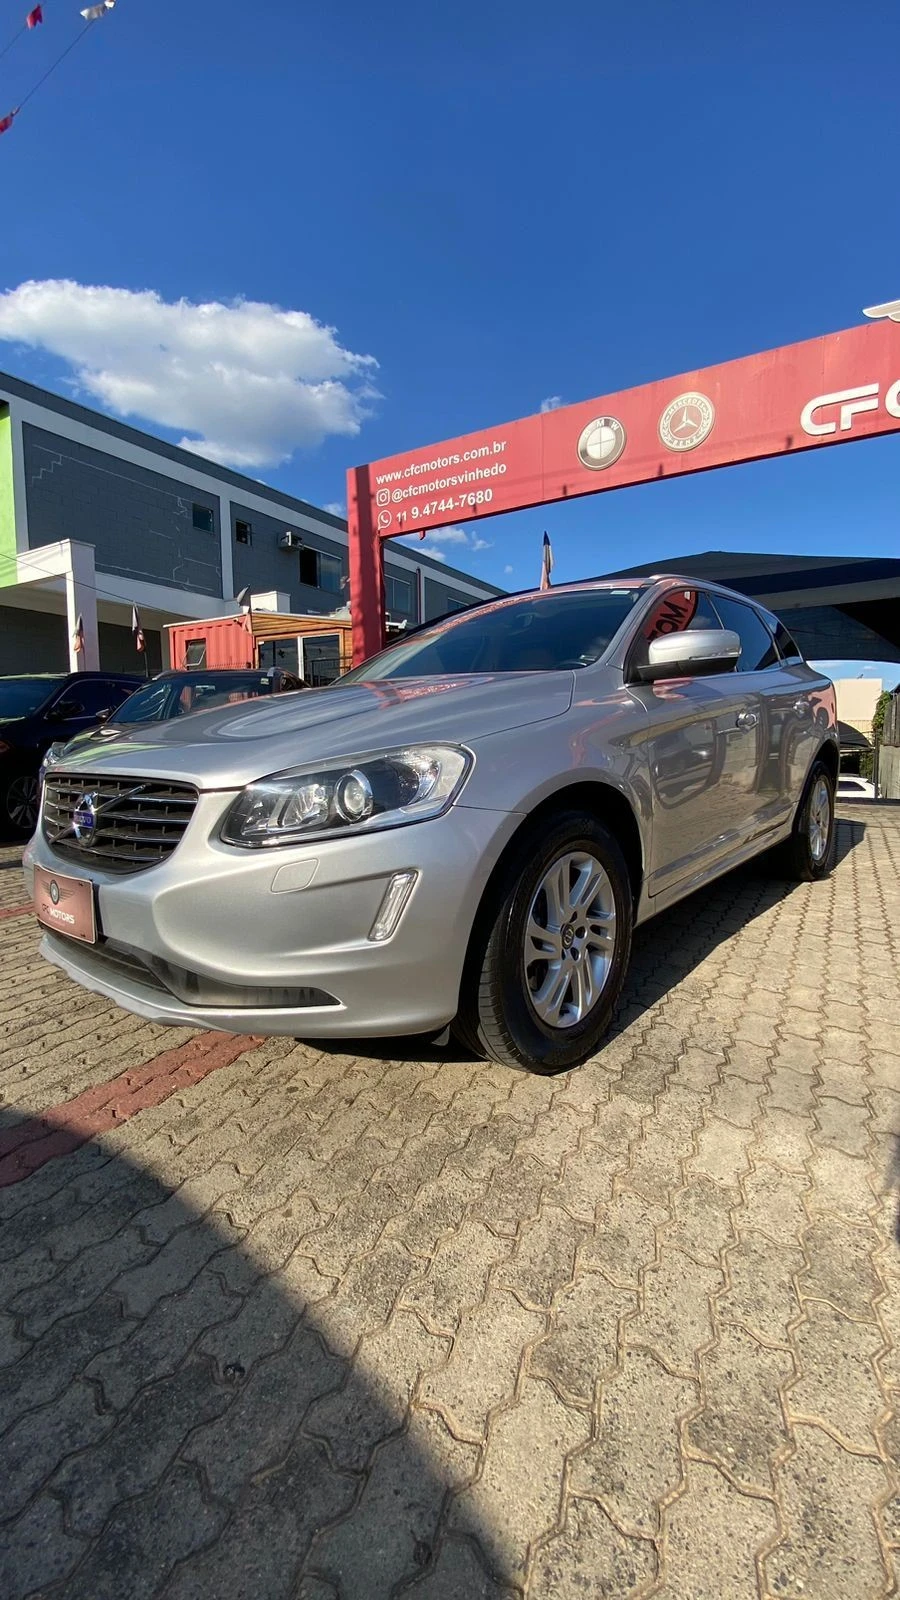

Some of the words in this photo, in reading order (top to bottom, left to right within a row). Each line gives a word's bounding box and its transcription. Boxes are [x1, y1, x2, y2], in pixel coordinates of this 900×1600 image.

[801, 380, 900, 435] CF
[584, 419, 620, 439] BMW
[376, 441, 506, 484] www.cfcmotors.com.br
[392, 463, 507, 503] @cfcmotorsvinhedo
[396, 511, 407, 522] 11
[411, 489, 493, 519] 9.4744-7680
[49, 907, 75, 925] MOTORS
